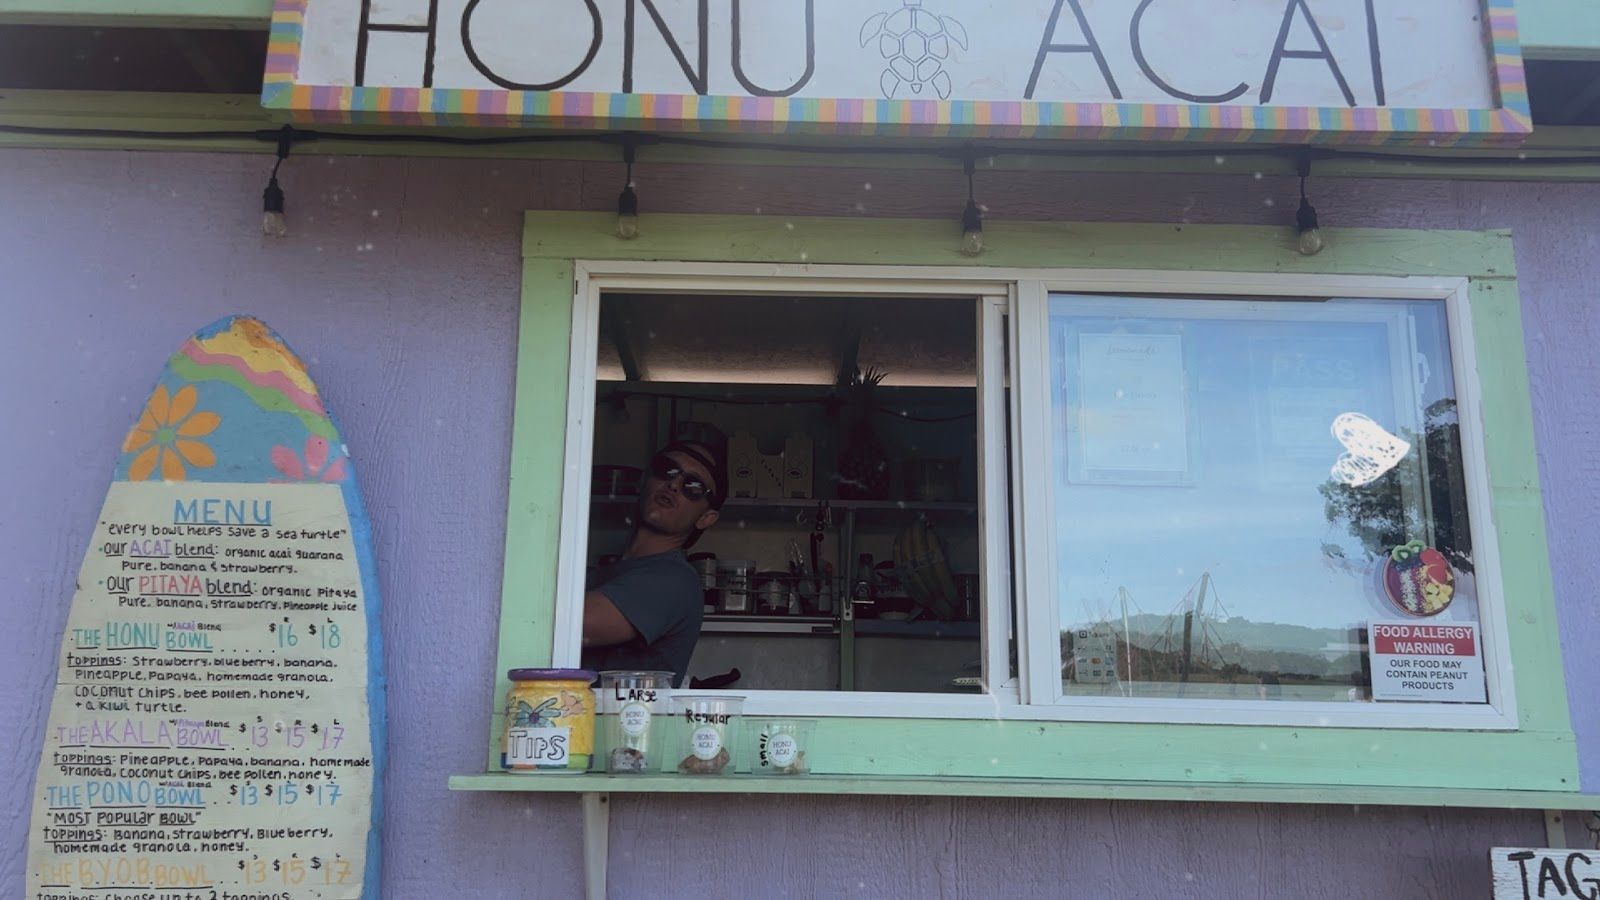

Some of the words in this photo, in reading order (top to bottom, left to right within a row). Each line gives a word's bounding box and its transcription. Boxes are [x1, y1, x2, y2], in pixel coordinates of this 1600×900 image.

[355, 0, 815, 97] HONU
[1023, 0, 1387, 108] ACAI
[174, 499, 272, 524] MENU
[152, 524, 184, 536] bowl
[228, 527, 256, 537] save
[261, 528, 270, 538] a
[276, 529, 298, 540] sea
[104, 542, 128, 554] our
[129, 539, 172, 556] ACAI
[225, 547, 267, 558] organic
[269, 547, 292, 558] acai
[296, 549, 345, 560] guarana
[160, 561, 206, 571] banana
[139, 574, 203, 594] PITAYA
[262, 586, 312, 598] organic
[72, 628, 102, 647] THE
[106, 622, 160, 649] HONU
[165, 631, 213, 650] BOWL
[1374, 626, 1410, 637] FOOD
[1413, 627, 1472, 640] ALLERGY
[1393, 642, 1455, 655] WARNING
[1390, 659, 1411, 668] OUR
[1413, 660, 1440, 668] FOOD
[1442, 661, 1462, 669] MAY
[207, 672, 273, 682] homemade
[1386, 670, 1427, 679] CONTAIN
[1430, 671, 1468, 680] PEANUT
[1402, 681, 1454, 690] PRODUCTS
[184, 688, 208, 699] bee
[86, 701, 95, 711] a
[686, 708, 731, 725] Regular
[57, 726, 89, 744] THE
[91, 719, 173, 746] AKALA
[177, 728, 229, 747] BOWL
[509, 730, 566, 761] TIPS
[310, 757, 370, 767] homemade
[219, 769, 241, 780] bee
[47, 786, 82, 806] THE
[87, 780, 150, 804] PONO
[155, 787, 206, 805] BOWL
[53, 842, 127, 854] homemade
[40, 862, 74, 884] THE
[78, 857, 150, 886] BYOB
[154, 863, 214, 886] BOWL
[1507, 851, 1600, 900] TAG
